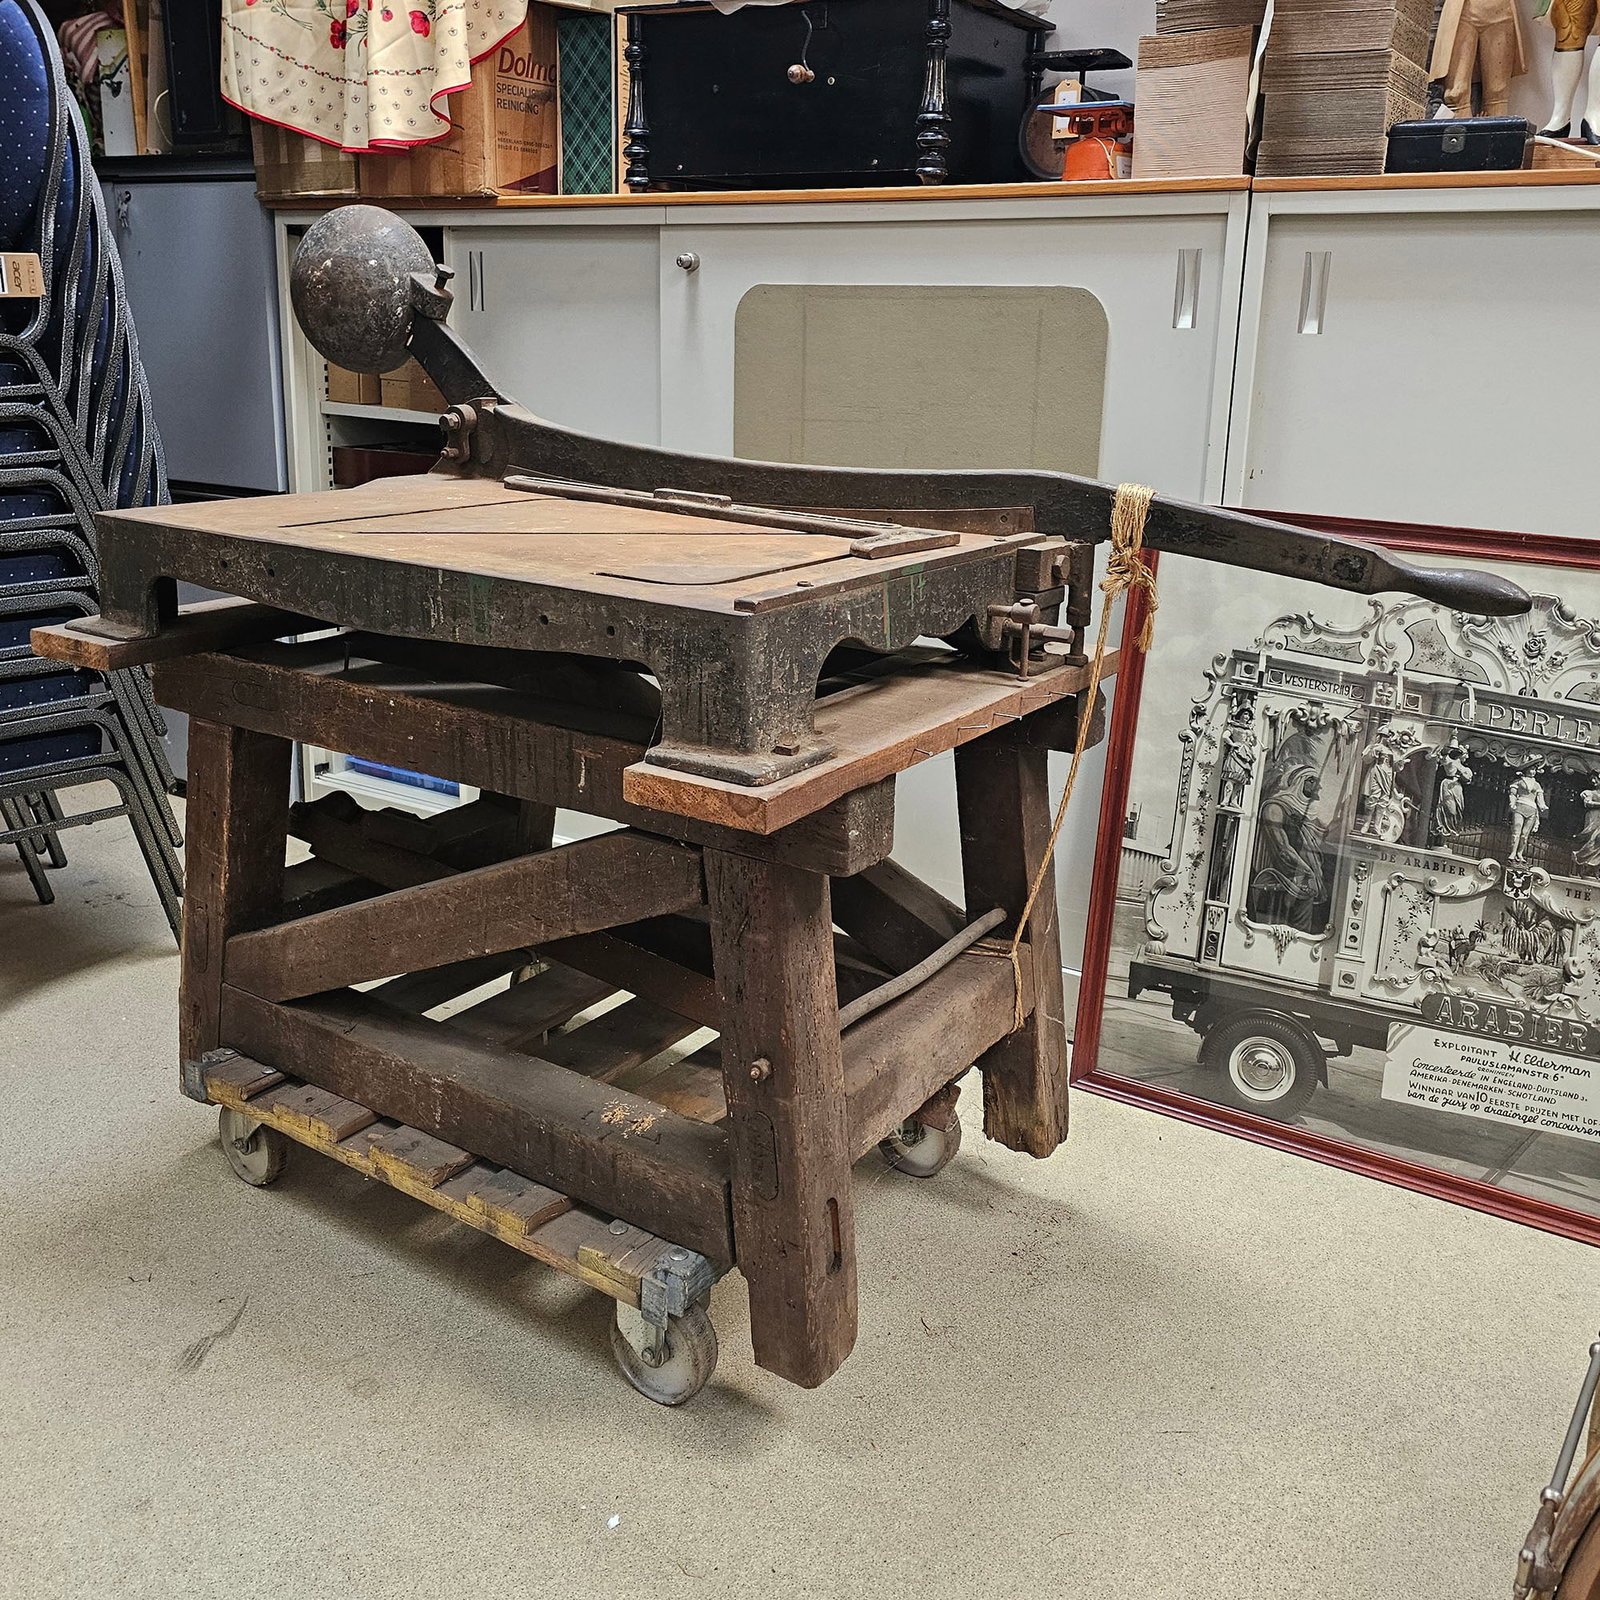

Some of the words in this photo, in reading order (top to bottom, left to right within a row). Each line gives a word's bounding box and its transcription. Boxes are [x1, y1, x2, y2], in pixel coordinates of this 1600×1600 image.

[497, 98, 539, 115] REINIGING
[12, 261, 23, 292] acer
[1381, 853, 1396, 863] DE
[1404, 857, 1466, 876] ARABIER
[1566, 888, 1590, 901] THE
[1435, 996, 1588, 1051] ARABIER
[1434, 1038, 1498, 1057] EXPLOITANT
[1412, 1057, 1476, 1079] Concerteerde
[1407, 1090, 1426, 1101] van
[1429, 1094, 1440, 1104] de
[1470, 1103, 1480, 1112] op
[1484, 1105, 1539, 1124] draaiorgel
[1409, 1080, 1454, 1097] WINNAAR
[1489, 1097, 1520, 1111] EERSTE
[1562, 1112, 1580, 1122] MET
